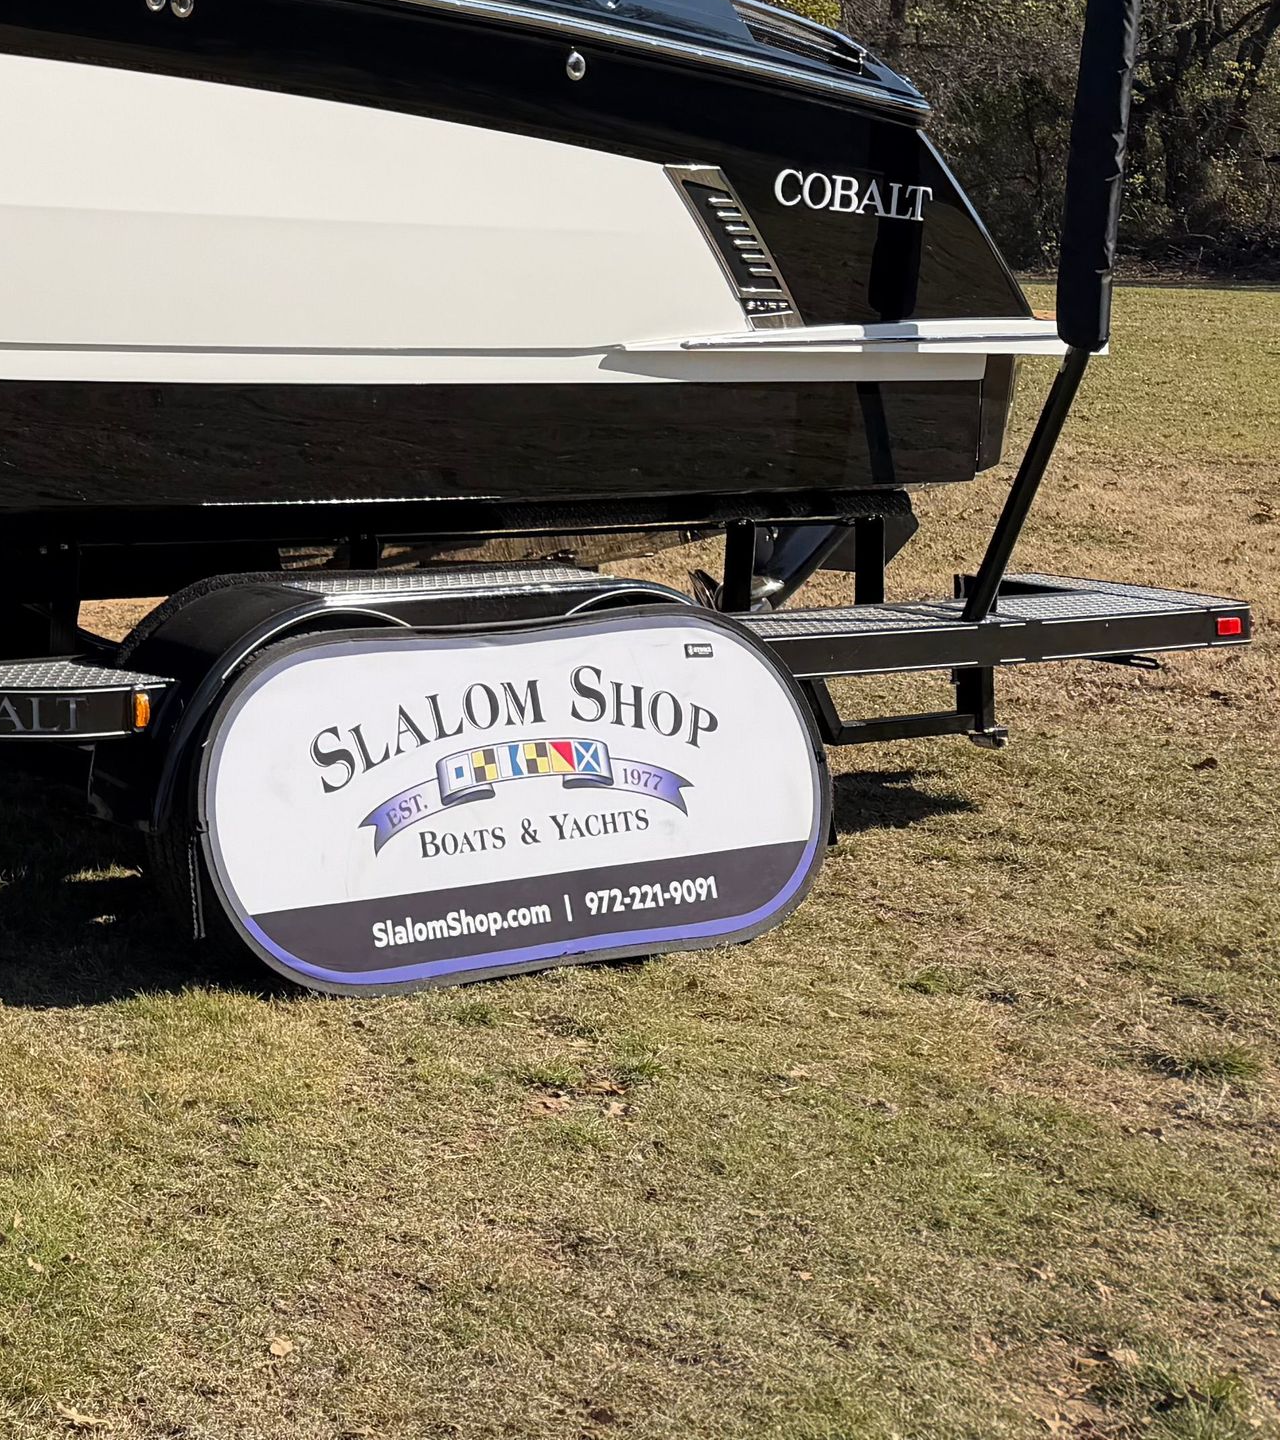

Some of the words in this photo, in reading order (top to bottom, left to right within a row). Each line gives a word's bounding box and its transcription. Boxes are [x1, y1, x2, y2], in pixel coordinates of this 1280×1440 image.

[774, 168, 933, 221] COBALT
[310, 680, 546, 793] SLALOM
[570, 665, 719, 749] SHOP
[385, 794, 428, 828] EST.
[622, 767, 663, 791] 1977
[419, 827, 506, 858] BOATS
[521, 818, 541, 845] &
[549, 809, 650, 840] YACHTS
[372, 905, 552, 948] SlalomShop.com
[585, 875, 719, 916] 972-221-9091
